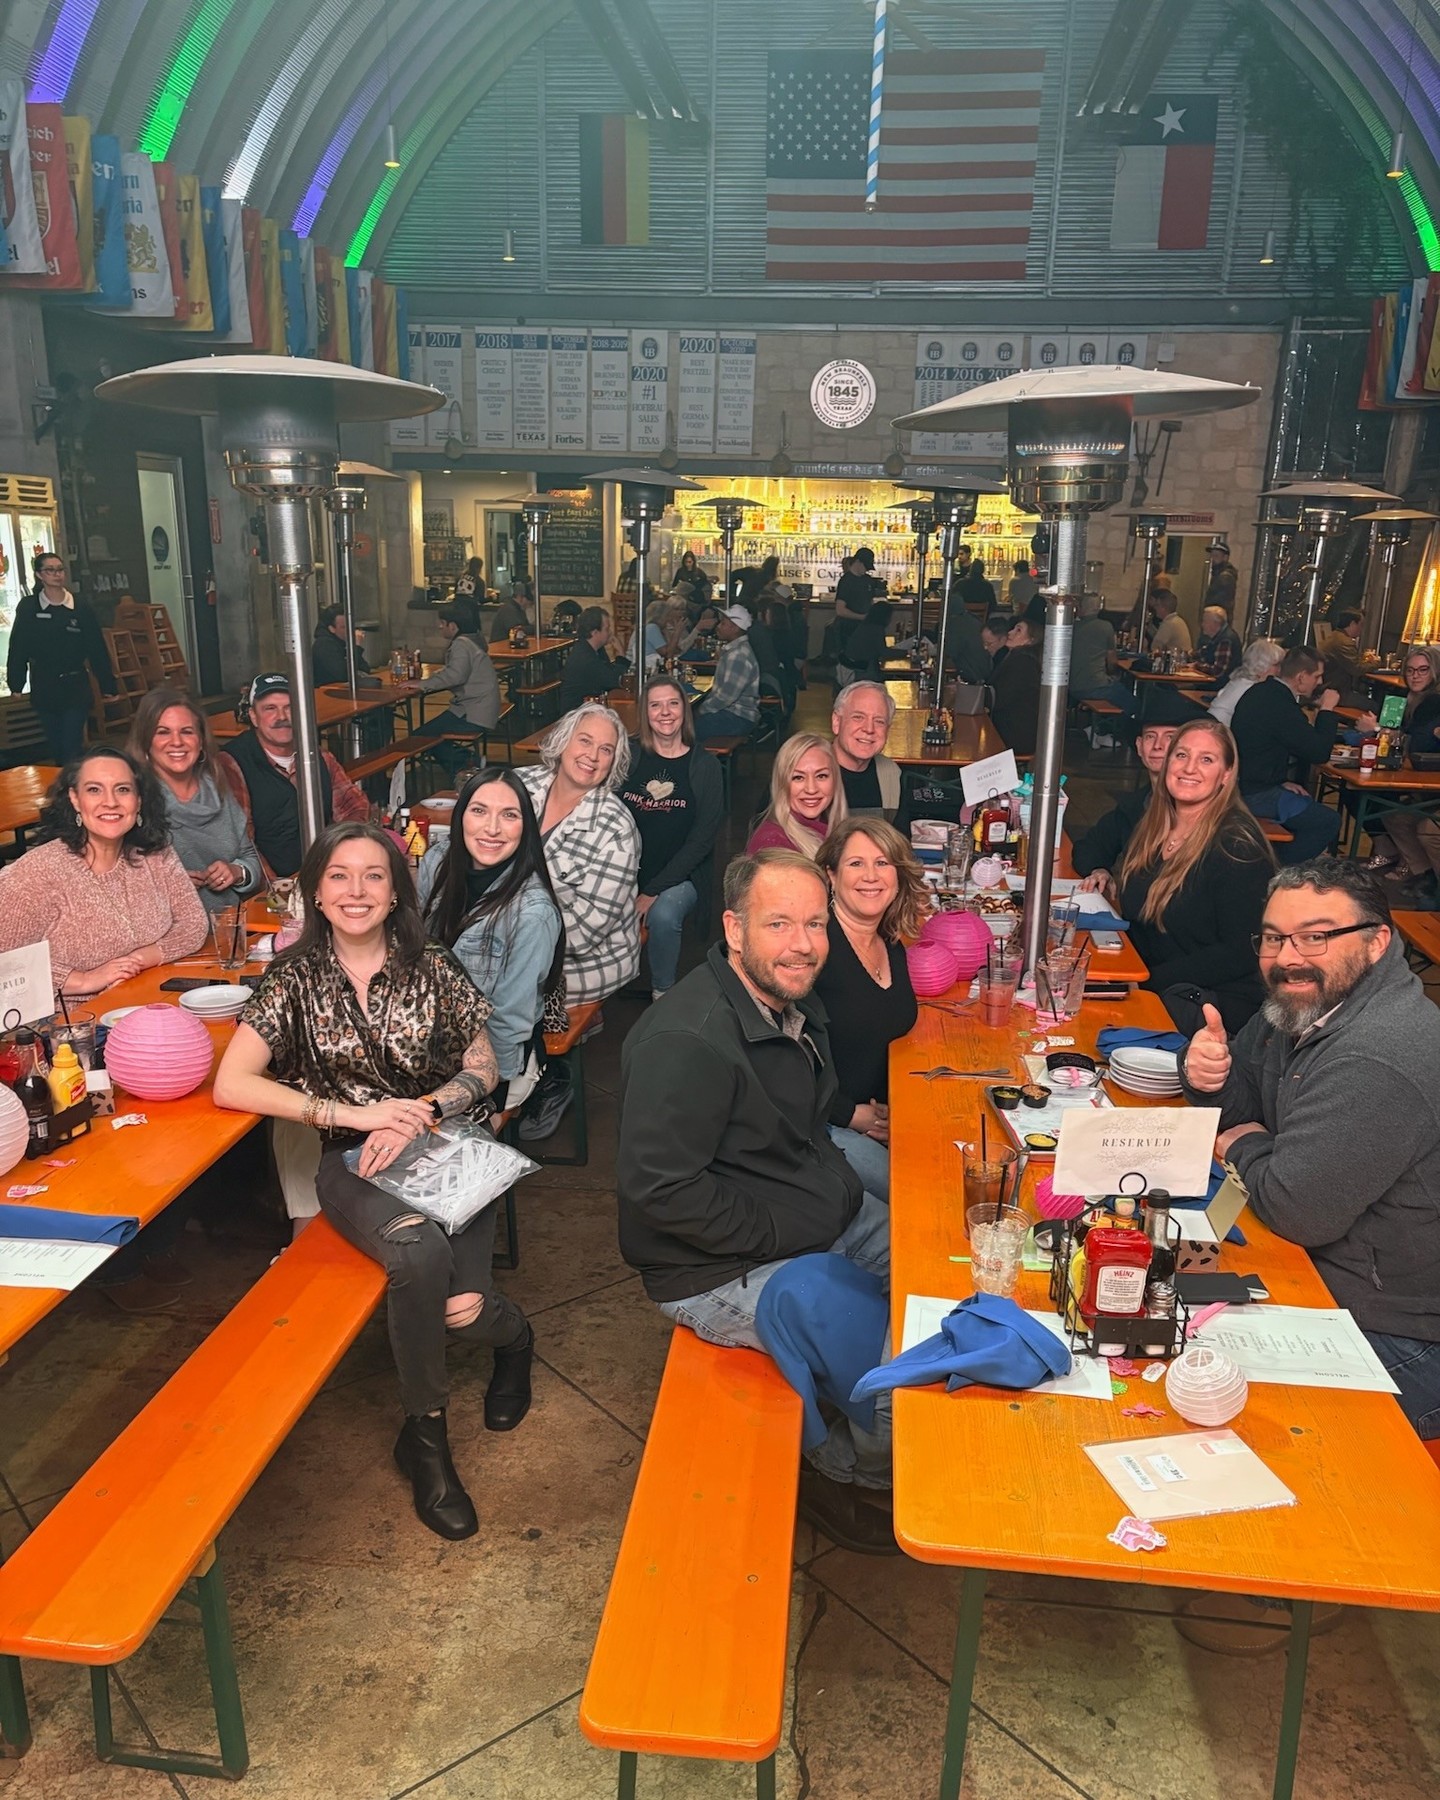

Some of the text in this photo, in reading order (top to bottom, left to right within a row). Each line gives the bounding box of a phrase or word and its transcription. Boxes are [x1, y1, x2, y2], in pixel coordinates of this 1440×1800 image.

[429, 333, 458, 347] 2017
[479, 334, 509, 348] 2018
[592, 339, 628, 348] 2018-2019
[681, 338, 715, 353] 2020
[722, 339, 754, 347] OCTOBER
[633, 367, 665, 381] 2020
[821, 367, 867, 387] NEW BRAUNFELS
[918, 367, 948, 379] 2014
[952, 367, 983, 379] 2016
[641, 385, 657, 401] #1
[828, 386, 859, 397] 1845
[638, 414, 659, 423] SALES
[644, 425, 653, 434] IN
[516, 433, 545, 441] TEXAS
[555, 434, 584, 444] Forbes
[637, 436, 660, 445] TEXAS
[976, 768, 1002, 782] RESERVED
[623, 791, 645, 803] PINK
[1101, 1138, 1171, 1148] RESERVED
[1113, 1269, 1135, 1278] HEINZ
